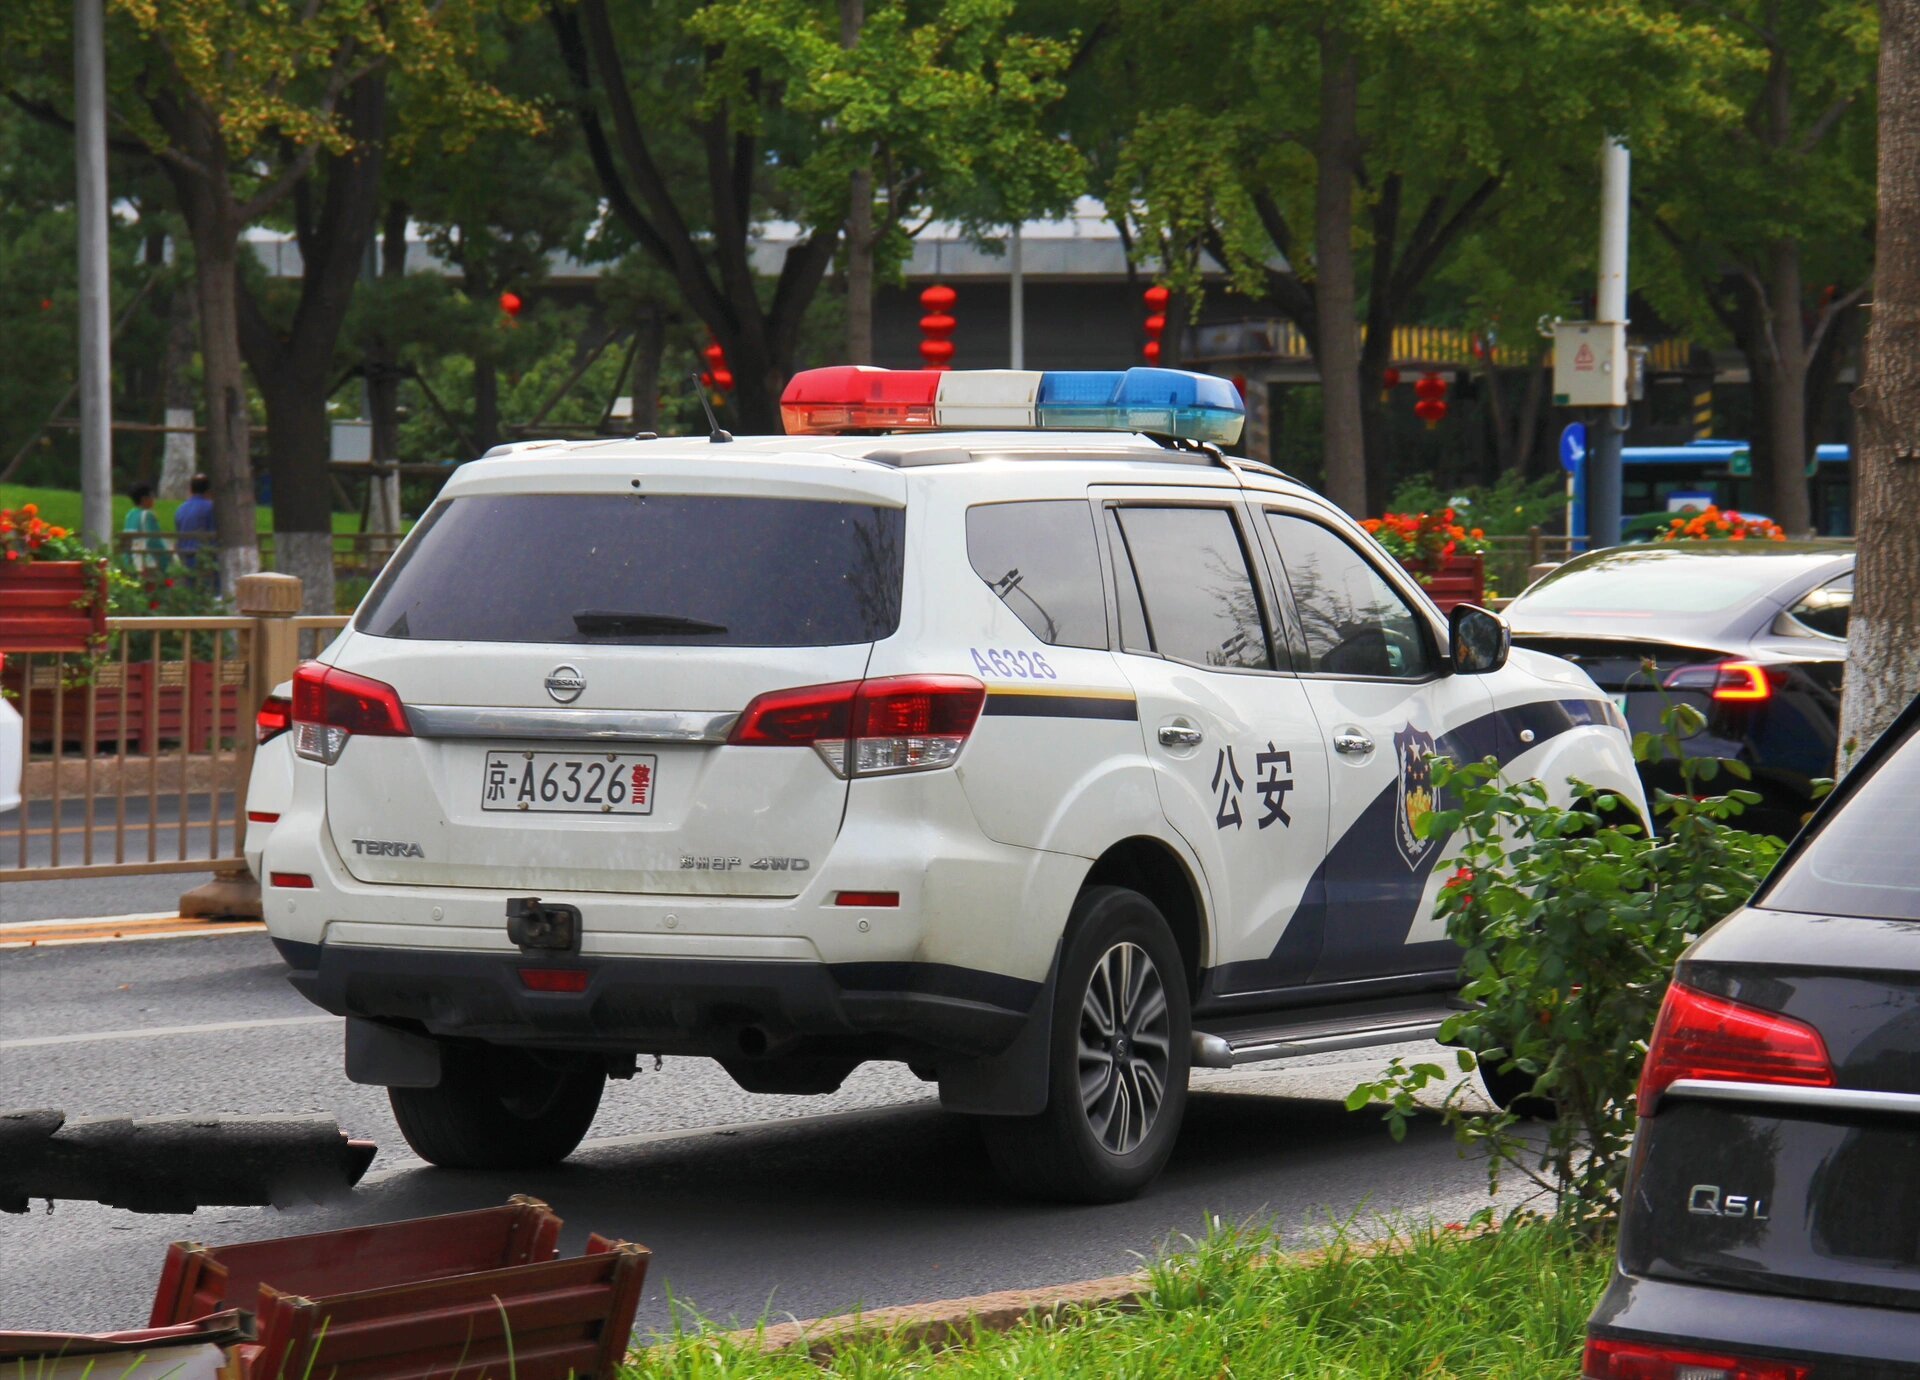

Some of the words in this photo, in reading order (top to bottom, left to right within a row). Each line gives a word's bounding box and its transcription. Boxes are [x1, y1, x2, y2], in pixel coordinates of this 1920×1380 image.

[970, 647, 1057, 680] A6326
[547, 679, 581, 687] NISSAN
[1211, 740, 1294, 831] 公安
[351, 837, 425, 859] TERRA
[749, 857, 810, 871] 4WD
